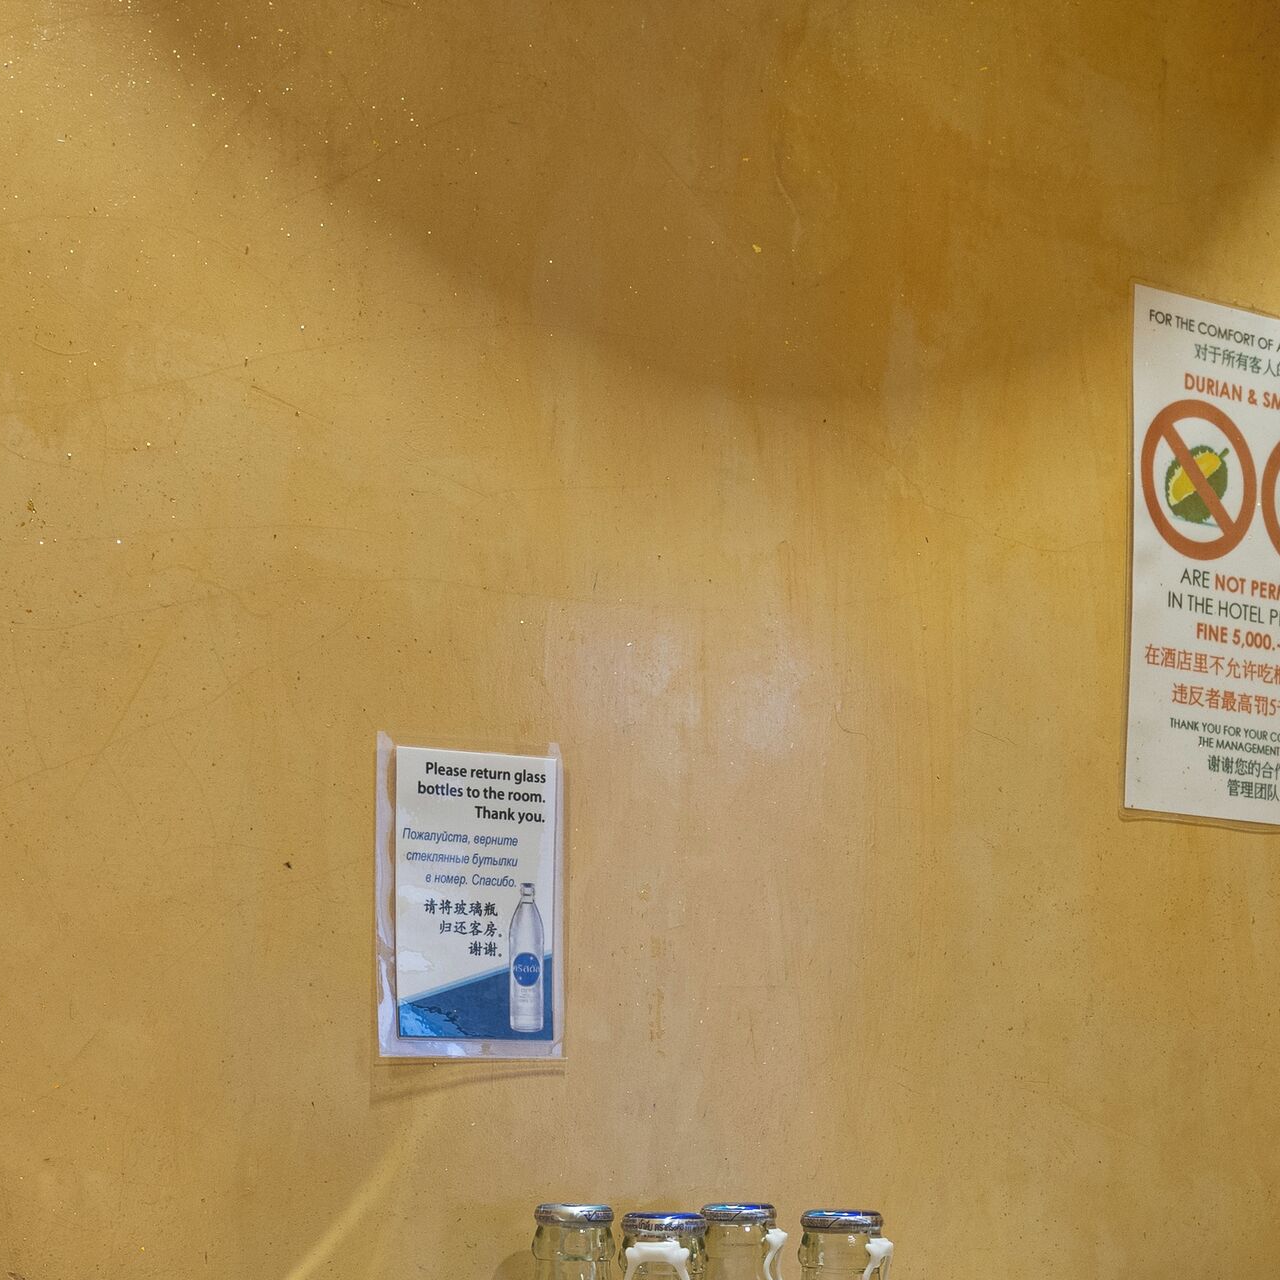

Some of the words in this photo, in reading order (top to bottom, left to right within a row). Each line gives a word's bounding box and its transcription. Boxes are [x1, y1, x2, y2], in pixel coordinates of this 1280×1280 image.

[1149, 309, 1172, 326] FOR
[1175, 315, 1195, 332] THE
[1198, 322, 1255, 347] COMFORT
[1258, 337, 1273, 350] OF
[1184, 372, 1242, 402] DURIAN
[1248, 389, 1257, 405] &
[1180, 568, 1210, 589] ARE
[1215, 573, 1246, 594] NOT
[1168, 590, 1182, 609] IN
[1187, 595, 1213, 616] THE
[1219, 600, 1264, 624] HOTEL
[1196, 622, 1228, 644] FINE
[1170, 717, 1199, 732] THANK
[1202, 722, 1221, 735] YOU
[1223, 725, 1241, 738] FOR
[1244, 728, 1268, 741] YOUR
[1198, 736, 1214, 748] THE
[1216, 738, 1280, 756] MANAGEMENT
[425, 761, 467, 778] Please
[470, 768, 511, 781] return
[514, 769, 546, 785] glass
[417, 781, 463, 797] bottles
[467, 787, 480, 798] to
[483, 786, 505, 800] the
[508, 792, 546, 803] room.
[1227, 779, 1280, 802] 管理团队
[475, 805, 515, 821] Thank
[517, 811, 546, 824] you.
[402, 827, 471, 844] Пожалуйста,
[473, 834, 518, 848] верните
[406, 851, 469, 864] стеклянные
[472, 853, 518, 868] бутылки
[425, 872, 431, 883] в
[434, 874, 468, 887] номер.
[472, 874, 517, 888] Спасибо.
[424, 899, 498, 917] 请将玻璃瓶
[439, 920, 502, 937] 归还客房。
[468, 941, 502, 957] 谢谢。
